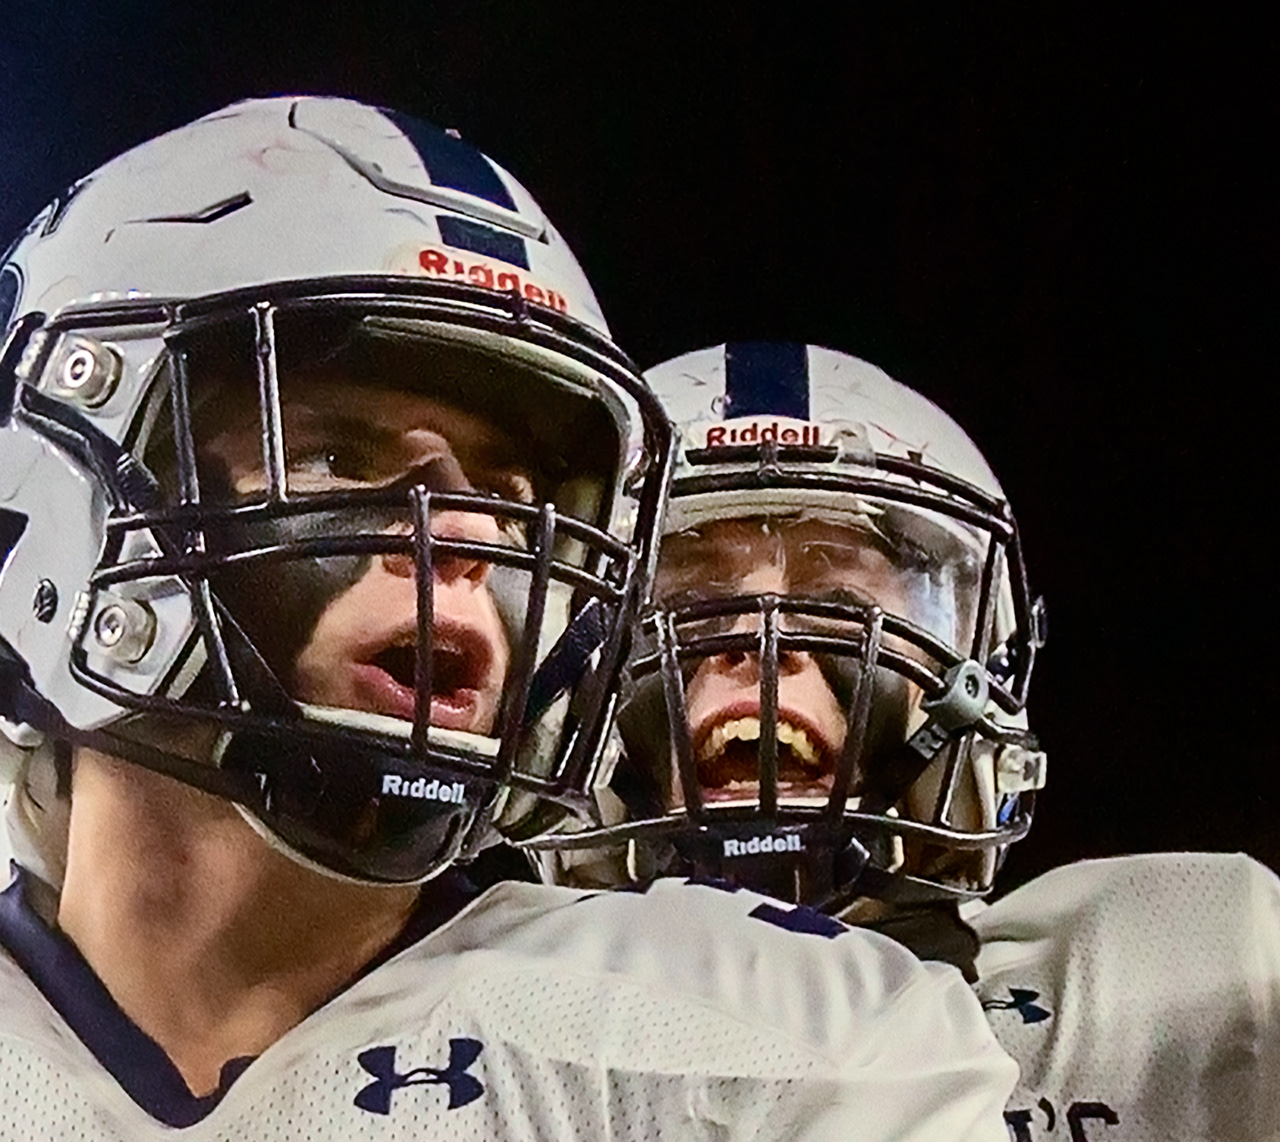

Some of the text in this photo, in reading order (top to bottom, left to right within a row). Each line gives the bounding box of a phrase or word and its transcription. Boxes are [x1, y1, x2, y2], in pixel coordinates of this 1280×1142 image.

[706, 422, 820, 448] Riddell
[381, 774, 466, 804] Riddell
[723, 834, 802, 857] Riddell
